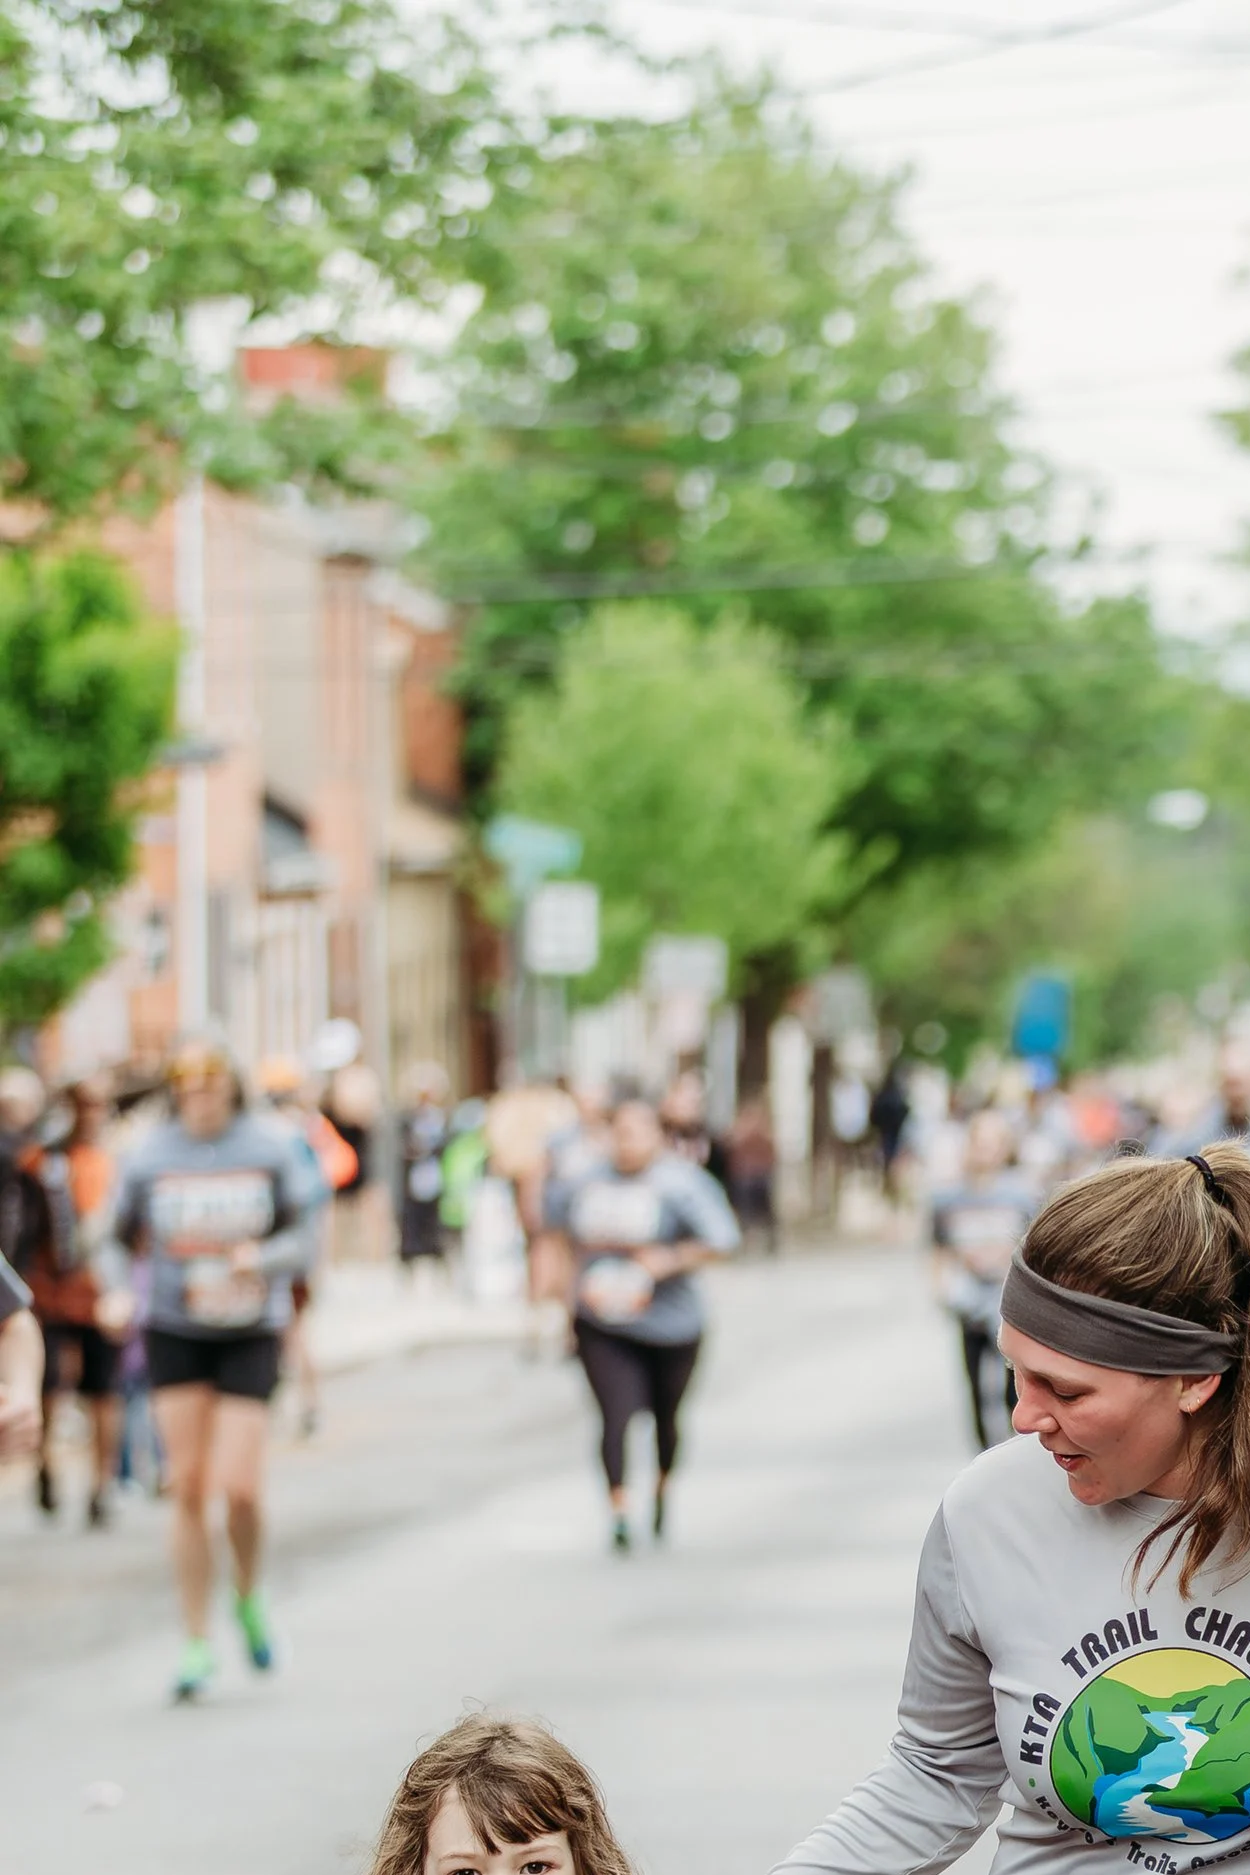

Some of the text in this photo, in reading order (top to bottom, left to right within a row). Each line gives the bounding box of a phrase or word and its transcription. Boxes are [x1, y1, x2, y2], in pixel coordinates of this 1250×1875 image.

[1019, 1691, 1062, 1766] KTA
[1061, 1607, 1158, 1680] TRAIL
[1126, 1840, 1178, 1875] Trails
